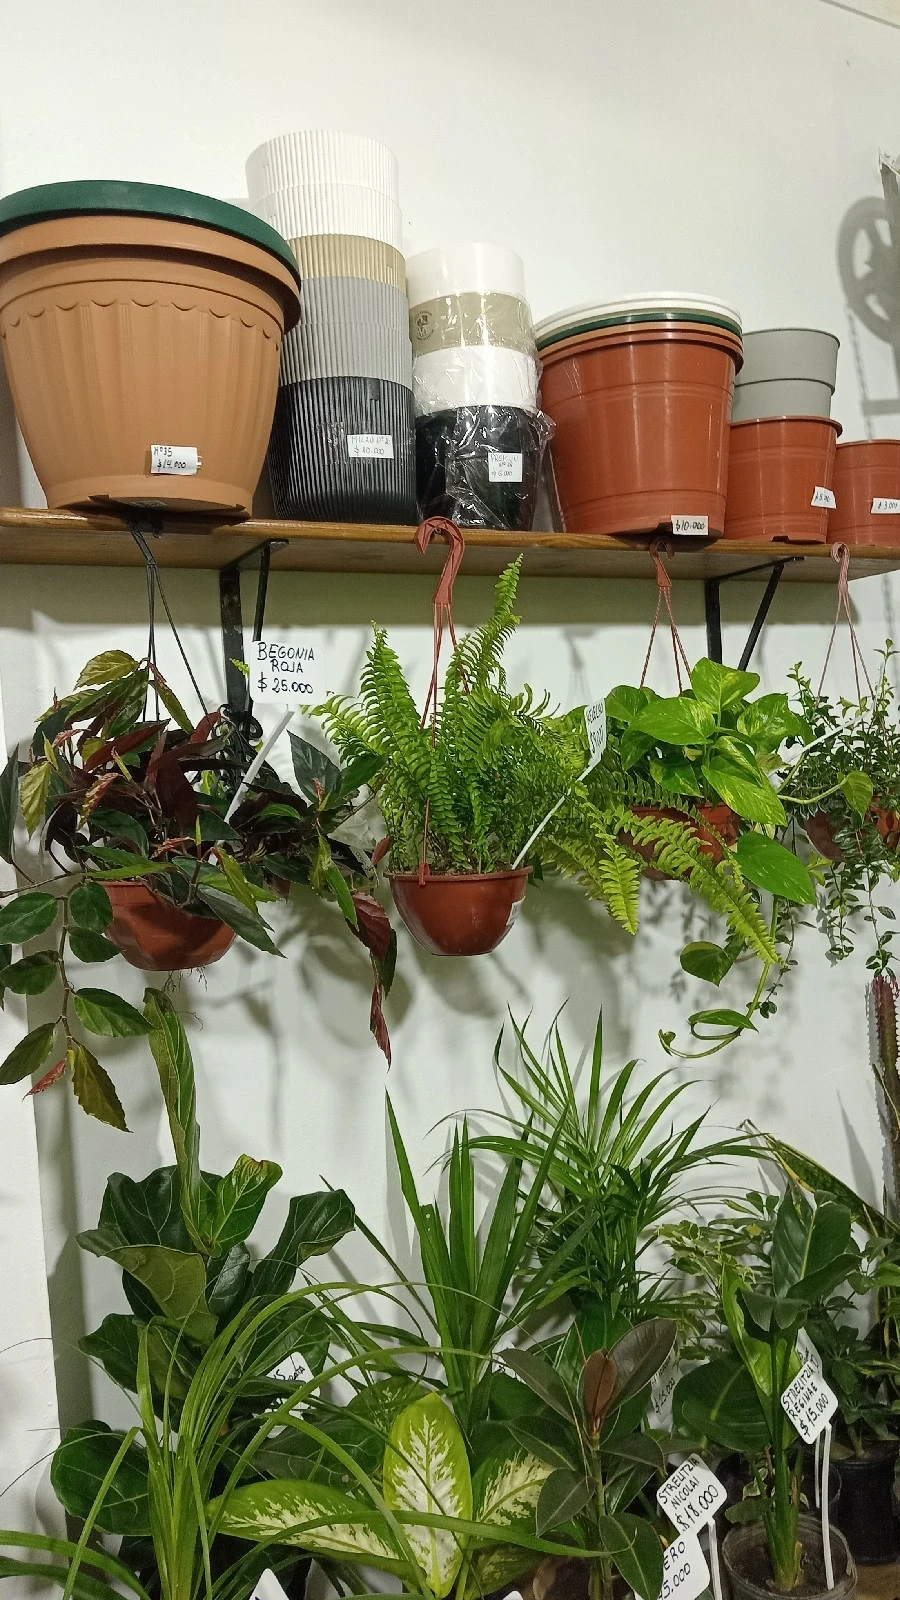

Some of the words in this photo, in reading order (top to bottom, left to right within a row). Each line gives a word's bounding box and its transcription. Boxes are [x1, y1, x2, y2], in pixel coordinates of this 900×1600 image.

[257, 641, 315, 661] BEGONIA
[270, 658, 304, 673] ROJA
[671, 1475, 700, 1510] NICOLAI
[663, 1541, 686, 1571] ERO
